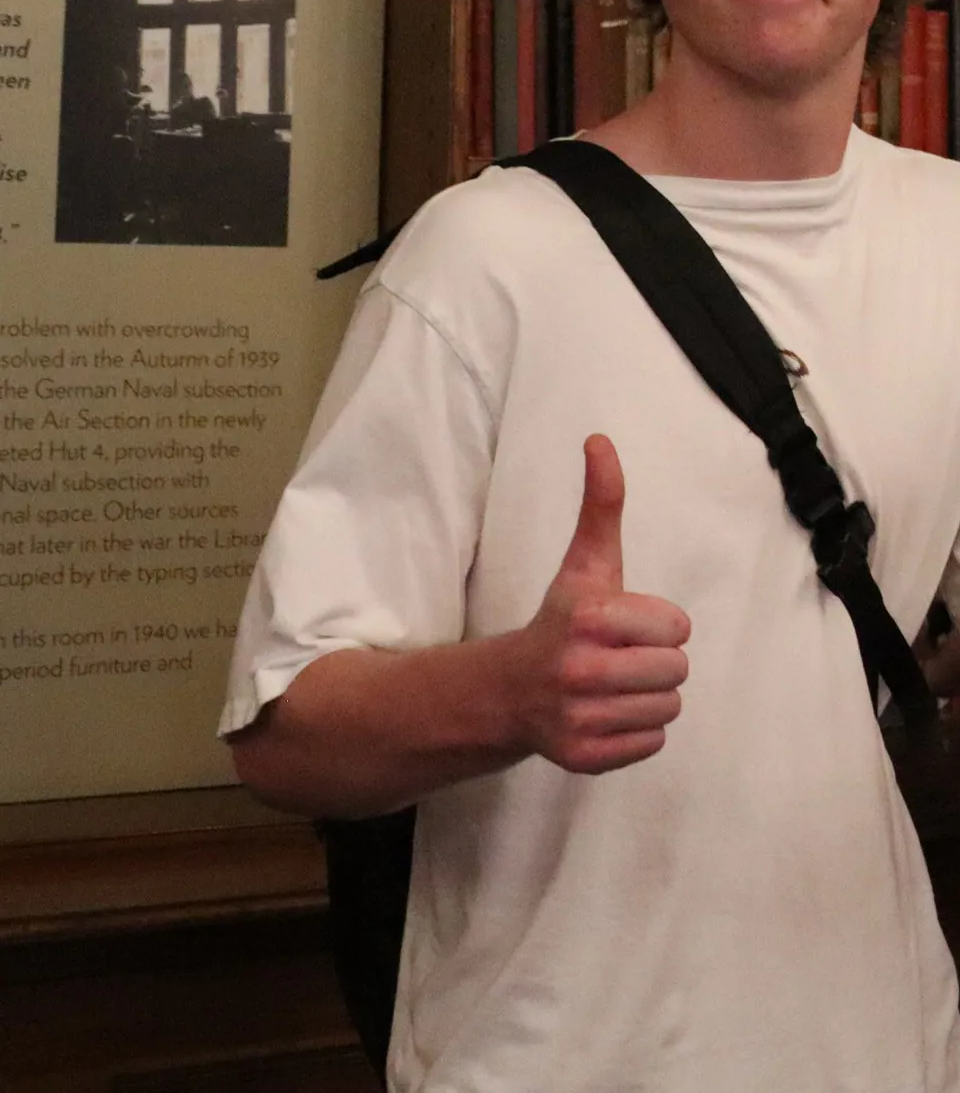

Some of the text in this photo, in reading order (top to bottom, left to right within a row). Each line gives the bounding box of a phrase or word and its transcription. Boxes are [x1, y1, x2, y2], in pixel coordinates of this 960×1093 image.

[77, 318, 116, 337] with
[122, 318, 250, 343] overcrowding
[70, 351, 88, 367] in
[94, 347, 124, 368] the
[130, 348, 210, 369] Autumn
[214, 347, 234, 368] of
[239, 350, 281, 370] 1939
[35, 377, 117, 400] German
[123, 378, 178, 399] Naval
[184, 379, 282, 399] subsection
[4, 408, 268, 433] the Air Section in the newly
[50, 440, 87, 461] Hut
[115, 438, 205, 465] providing
[210, 439, 241, 458] the
[62, 470, 166, 492] subsection
[172, 469, 210, 489] with
[103, 499, 161, 522] Other
[168, 504, 239, 520] sources
[30, 533, 75, 555] later
[79, 536, 97, 553] in
[103, 531, 134, 552] the
[139, 535, 172, 551] war
[178, 529, 208, 549] the
[70, 563, 95, 588] by
[100, 563, 132, 583] the
[136, 565, 197, 586] typing
[13, 626, 47, 649] this
[52, 631, 105, 647] room
[110, 626, 128, 644] in
[133, 622, 179, 644] 1940
[184, 627, 211, 640] we
[69, 656, 151, 677] furniture
[157, 648, 193, 672] and
